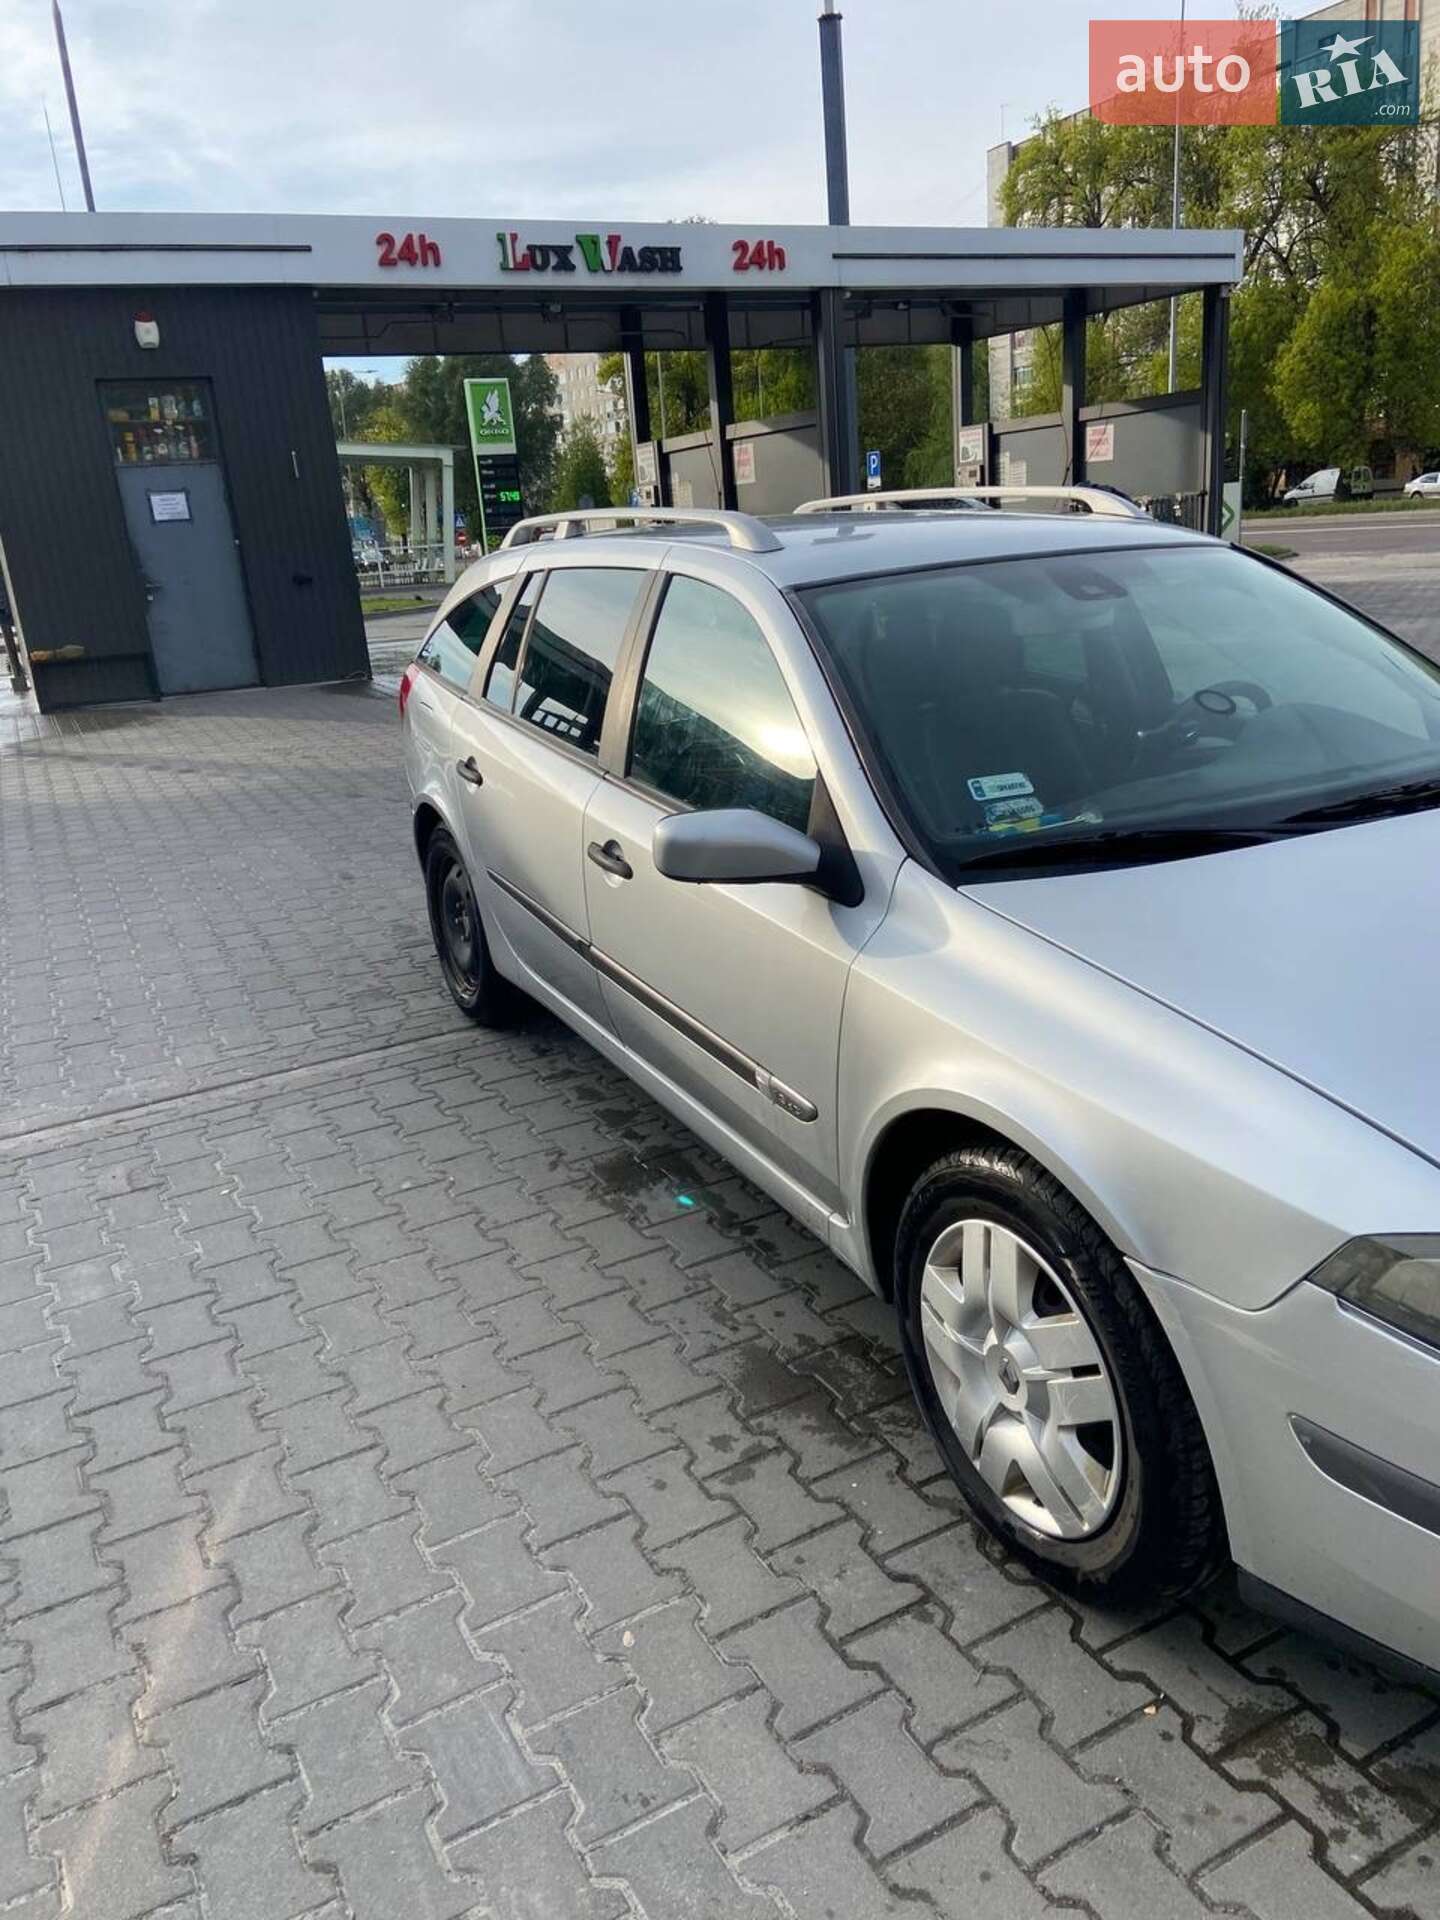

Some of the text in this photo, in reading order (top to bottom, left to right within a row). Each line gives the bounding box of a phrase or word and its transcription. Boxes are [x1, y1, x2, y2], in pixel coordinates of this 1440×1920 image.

[376, 232, 441, 267] 24h
[732, 239, 786, 271] 24h
[870, 455, 879, 475] P
